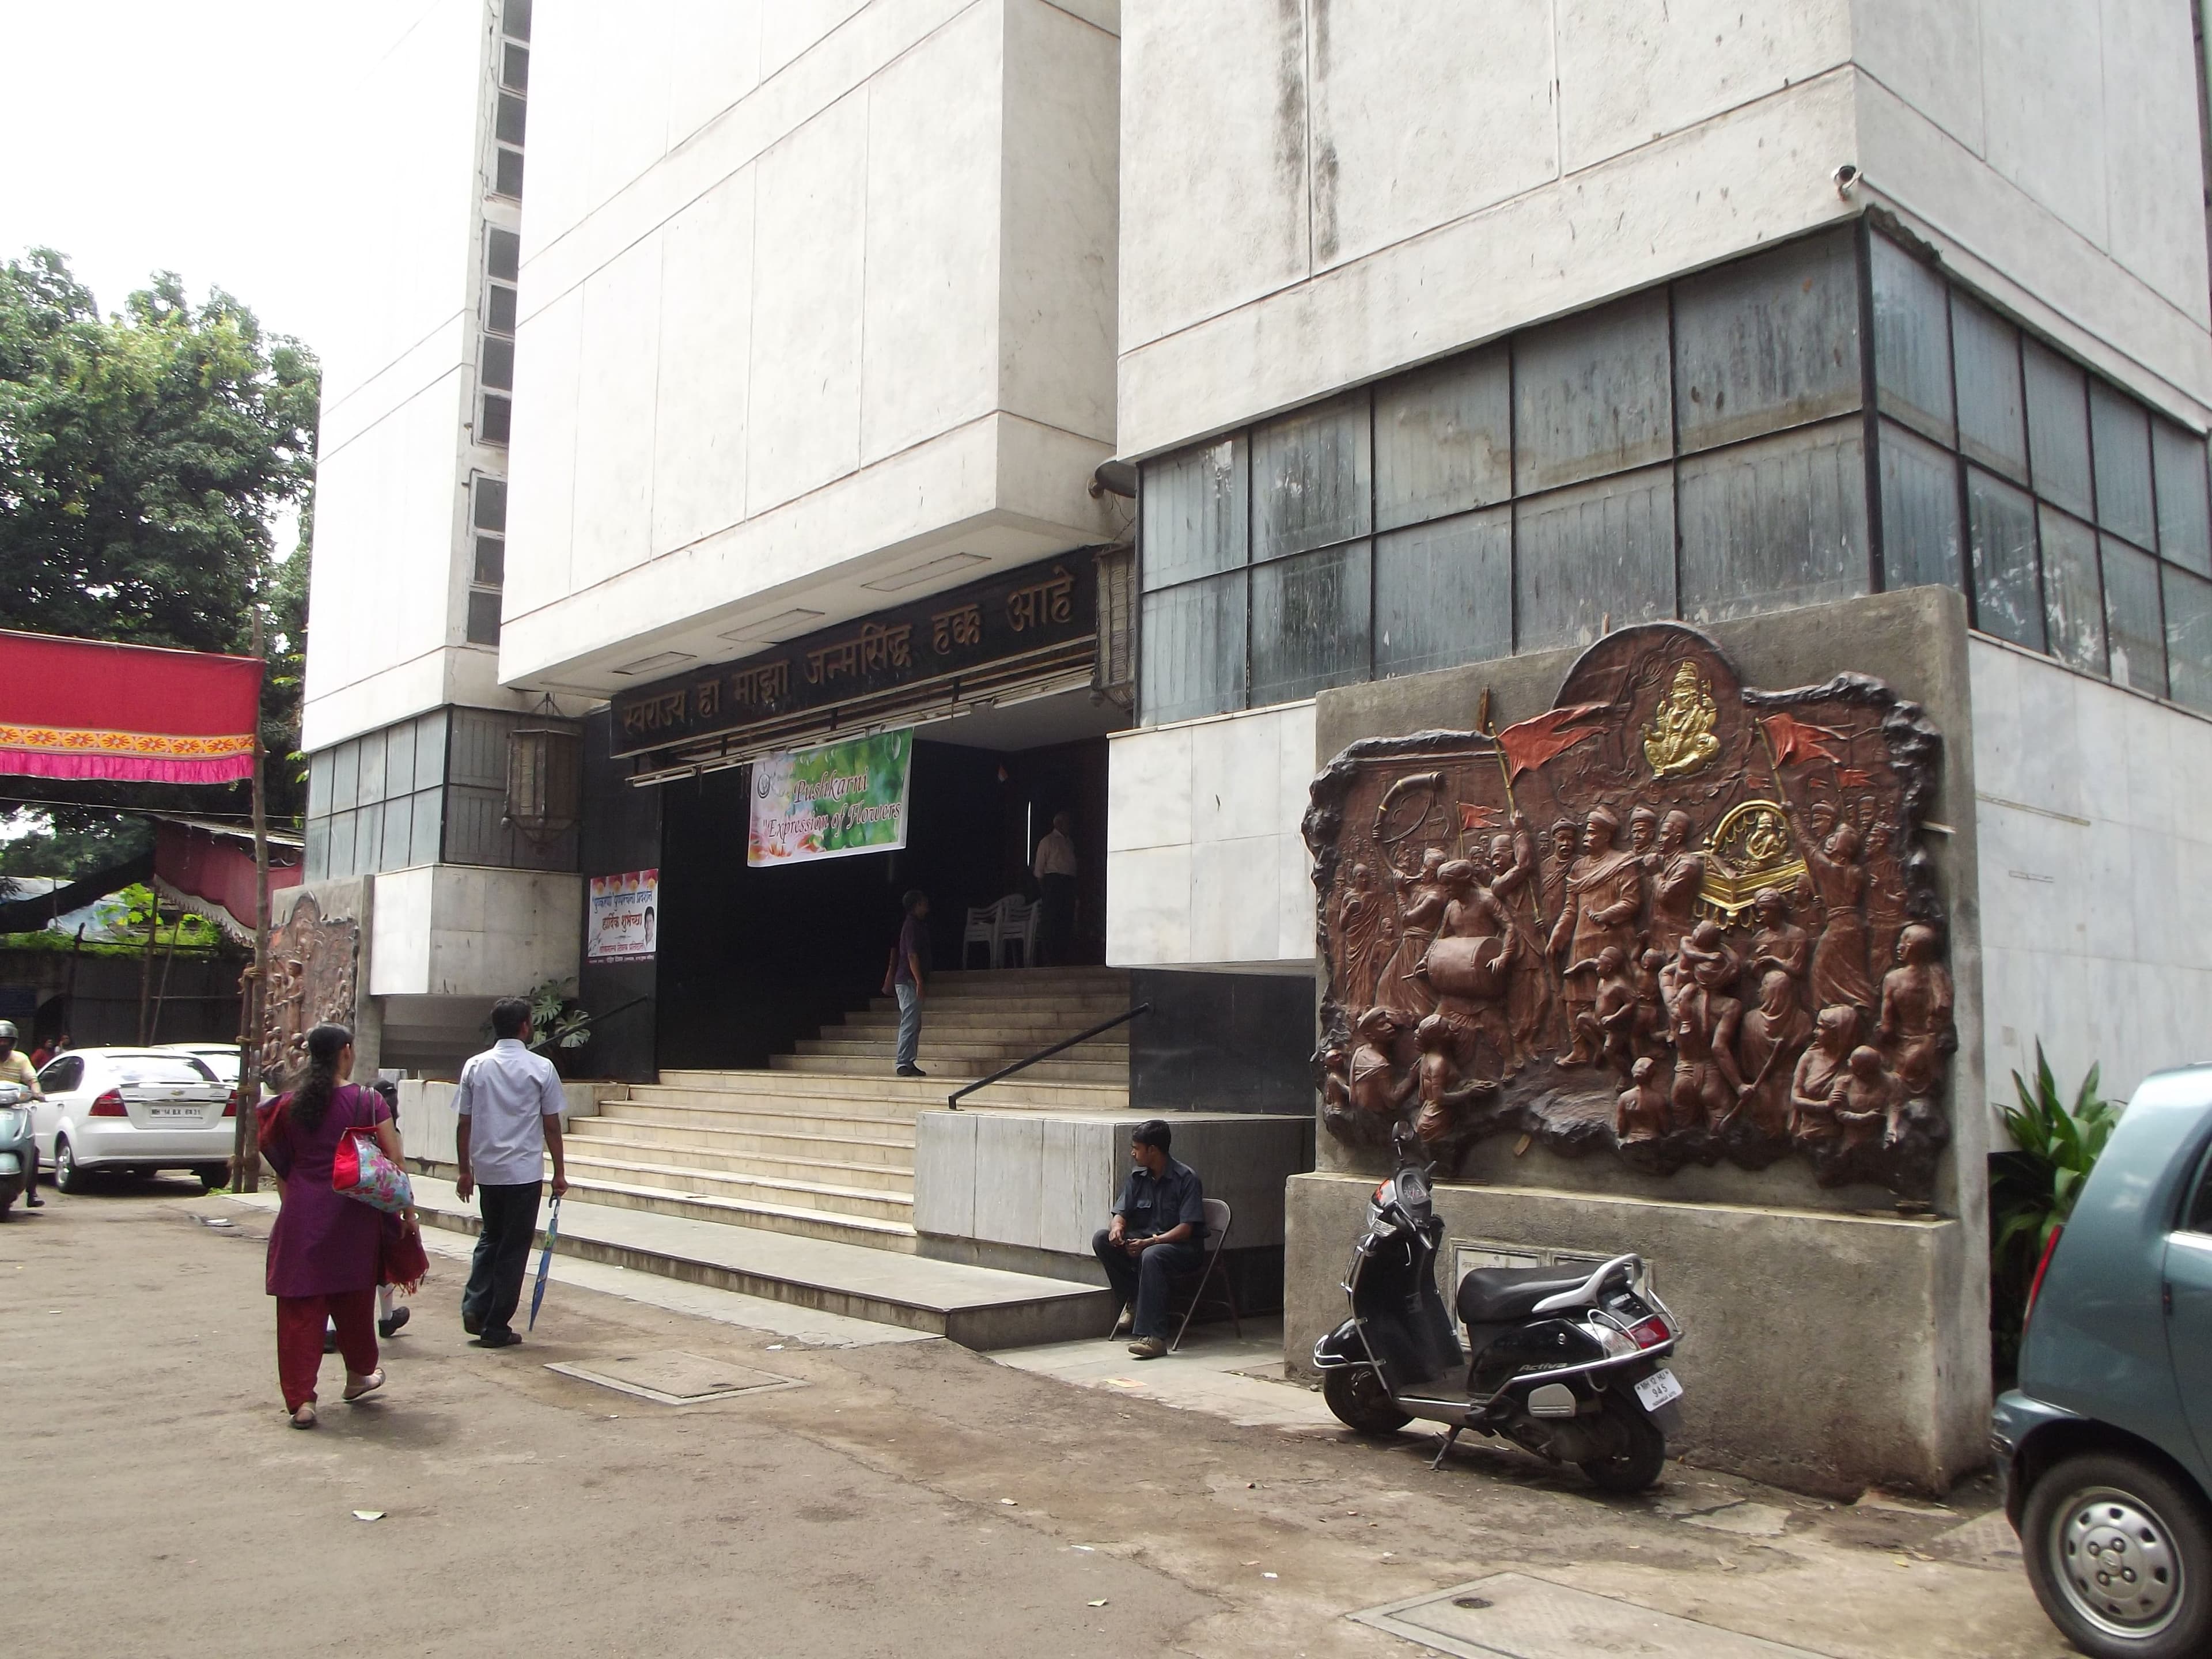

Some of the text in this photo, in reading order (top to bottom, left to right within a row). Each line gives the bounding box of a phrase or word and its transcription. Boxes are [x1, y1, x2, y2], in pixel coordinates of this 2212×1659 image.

[623, 691, 686, 734] स्वराज्य
[698, 679, 720, 718] हा
[732, 658, 790, 705] माझा
[805, 622, 912, 685] जन्मसिद्ध
[1006, 565, 1075, 632] आहे
[793, 766, 870, 804] Pushkarni
[831, 803, 849, 838] of
[1517, 1362, 1568, 1372] Activa
[1640, 1381, 1650, 1391] MH
[1650, 1377, 1657, 1385] 12
